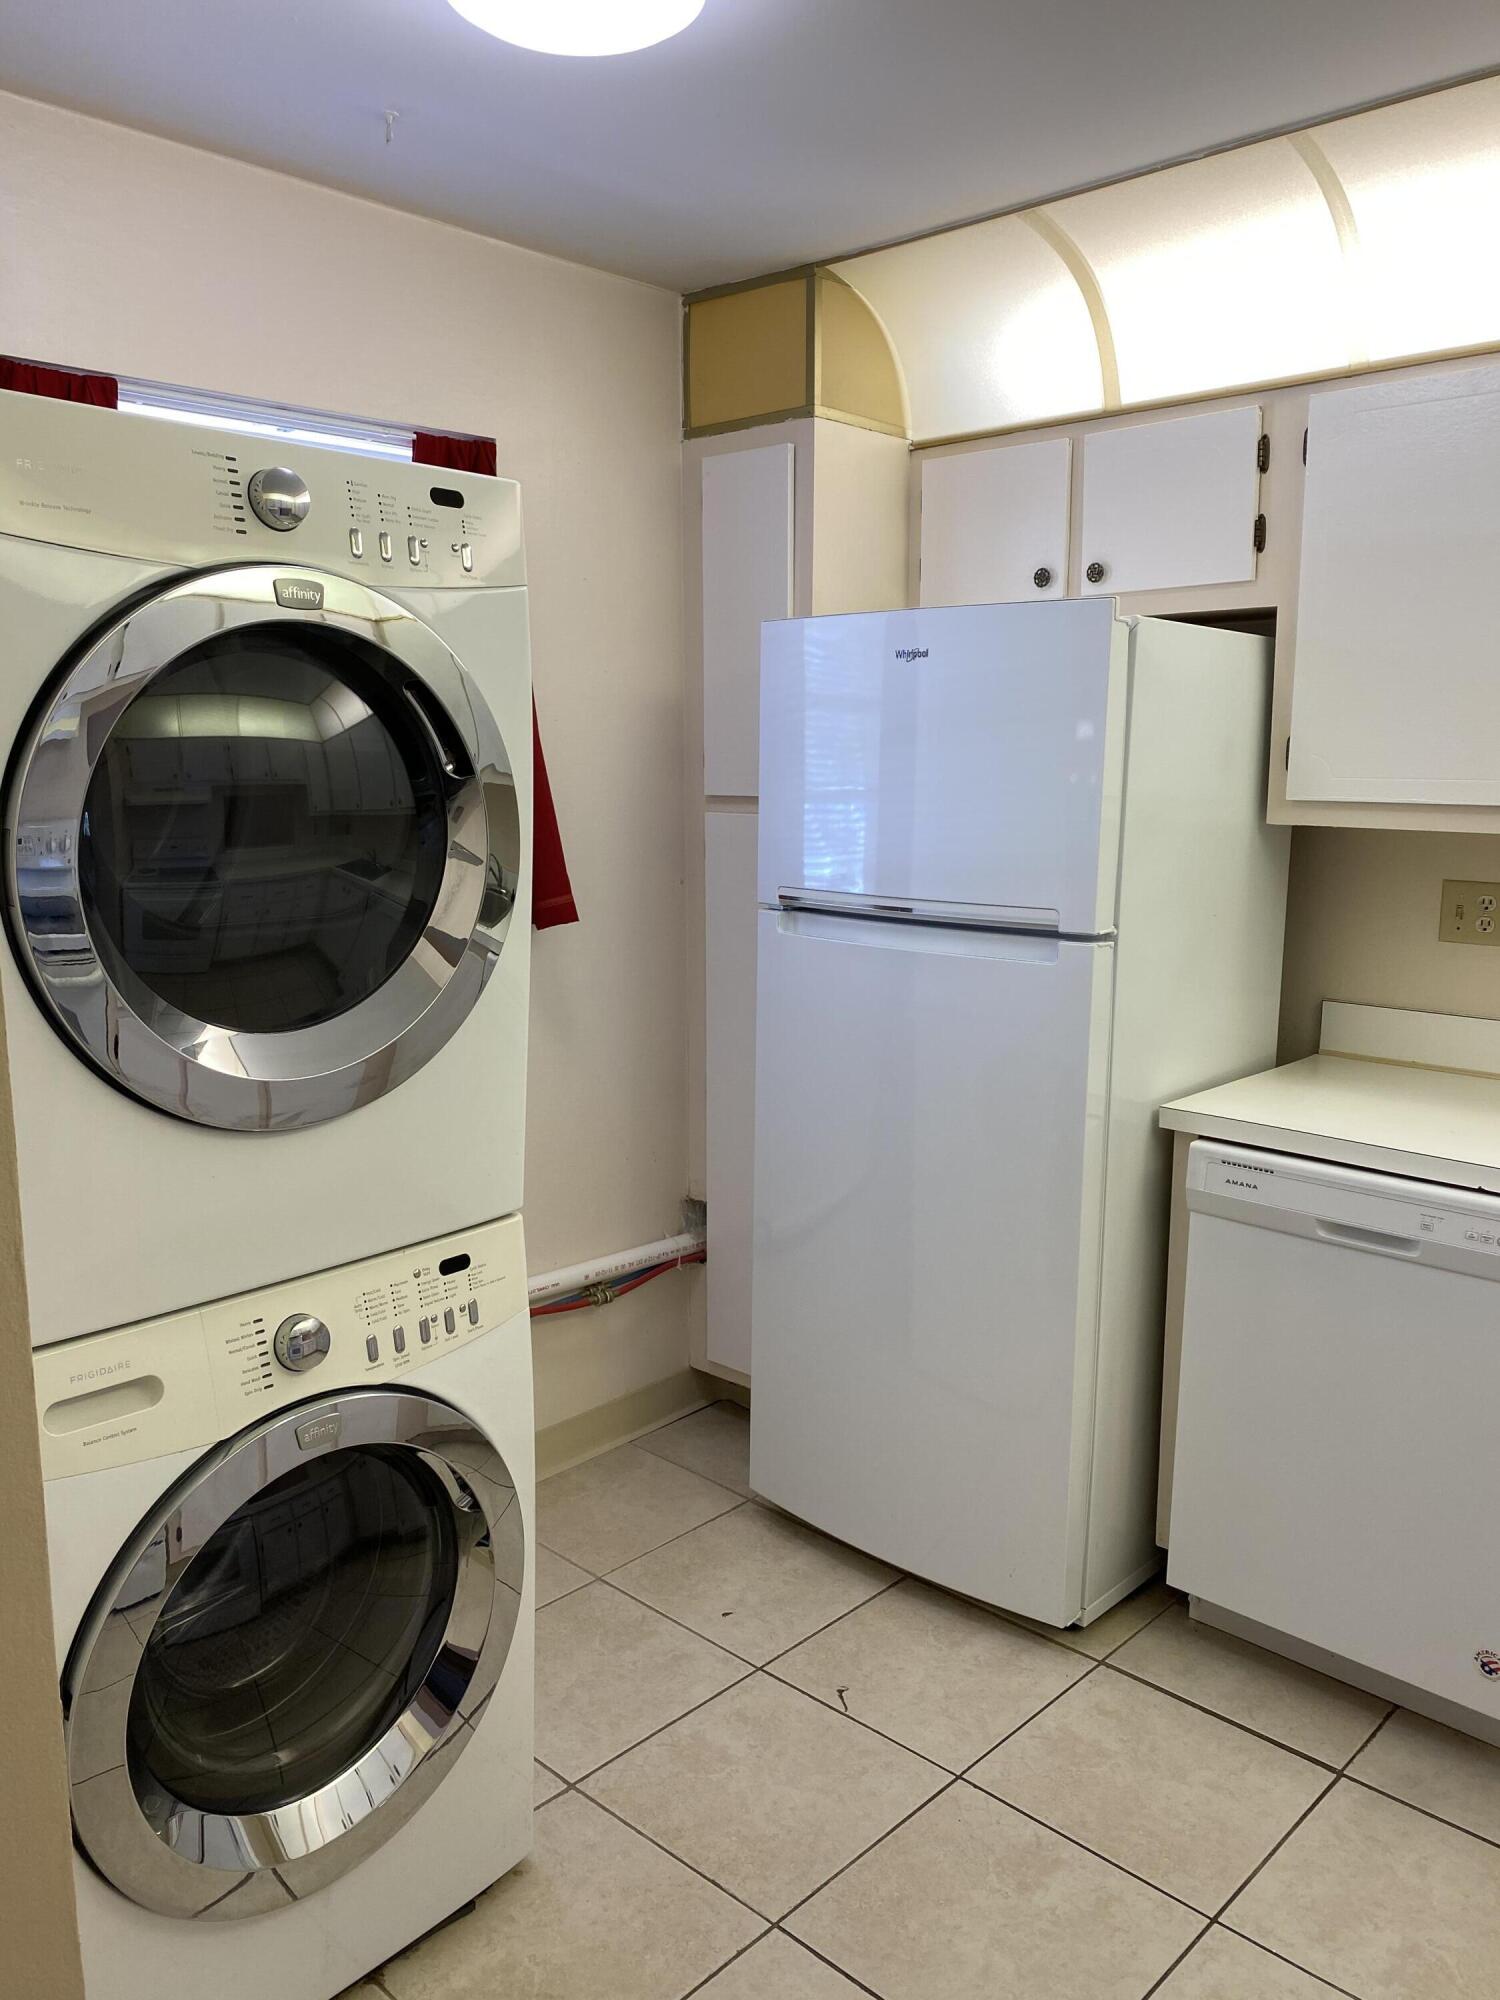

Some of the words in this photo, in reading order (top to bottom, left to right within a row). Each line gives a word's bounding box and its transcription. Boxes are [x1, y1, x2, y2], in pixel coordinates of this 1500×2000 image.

[281, 585, 321, 604] affinity
[895, 647, 929, 663] Whirlpool
[1225, 1178, 1258, 1190] AMANA
[69, 1360, 132, 1385] FRIGIDAIRE
[303, 1422, 338, 1443] affinity
